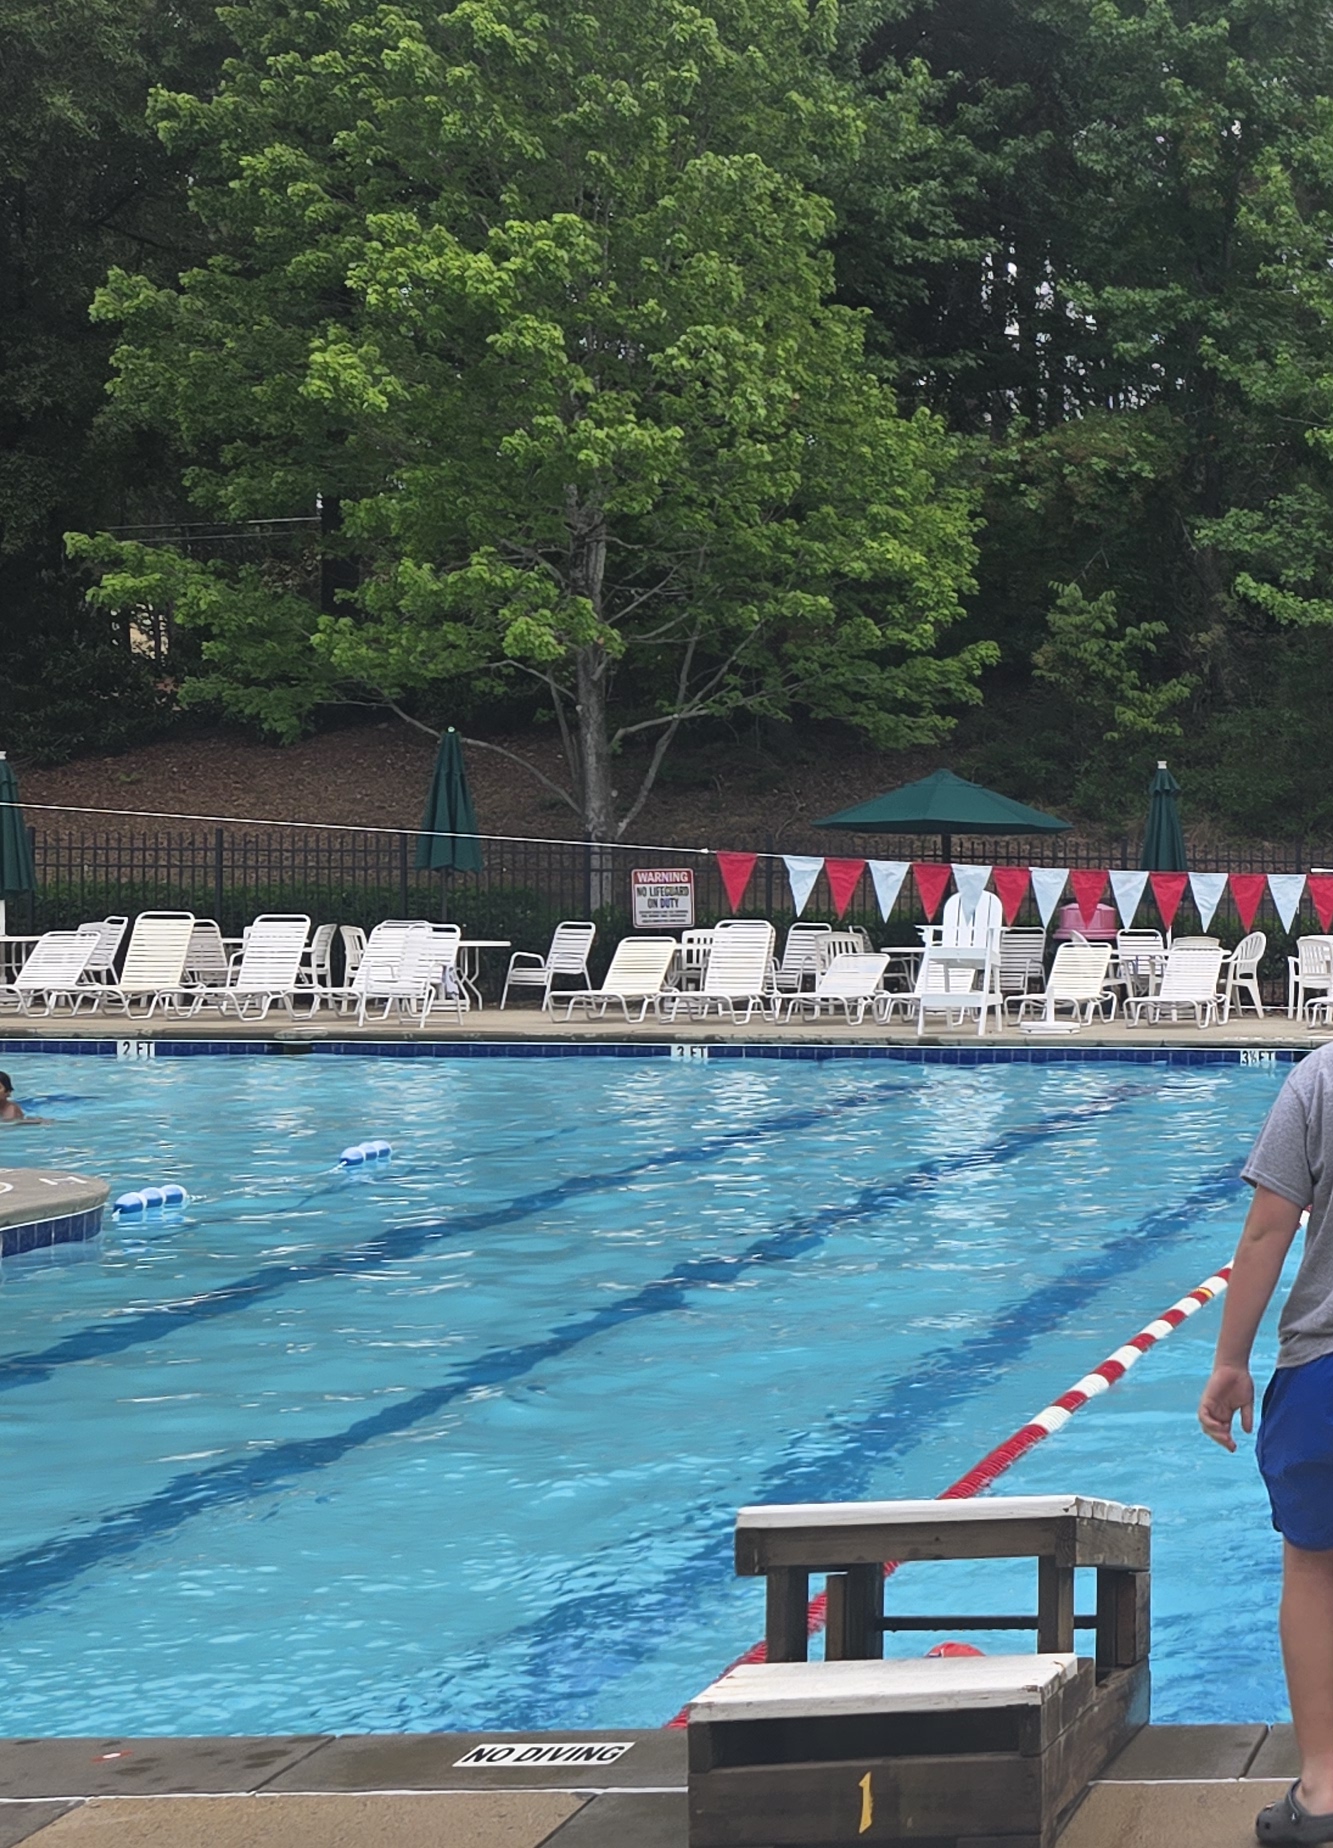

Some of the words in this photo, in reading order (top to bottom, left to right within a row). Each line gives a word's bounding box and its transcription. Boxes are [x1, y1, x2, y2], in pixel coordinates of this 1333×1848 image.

[637, 872, 688, 882] WARNING
[636, 886, 647, 897] NO
[649, 886, 689, 897] LIFEGUARD
[647, 898, 658, 908] ON
[660, 898, 679, 908] DUTY
[123, 1041, 130, 1055] 2
[136, 1041, 153, 1056] FT
[690, 1046, 707, 1058] FT
[1258, 1051, 1274, 1061] FT
[461, 1747, 515, 1763] NO
[512, 1745, 625, 1763] DIVING
[858, 1770, 874, 1834] 1
